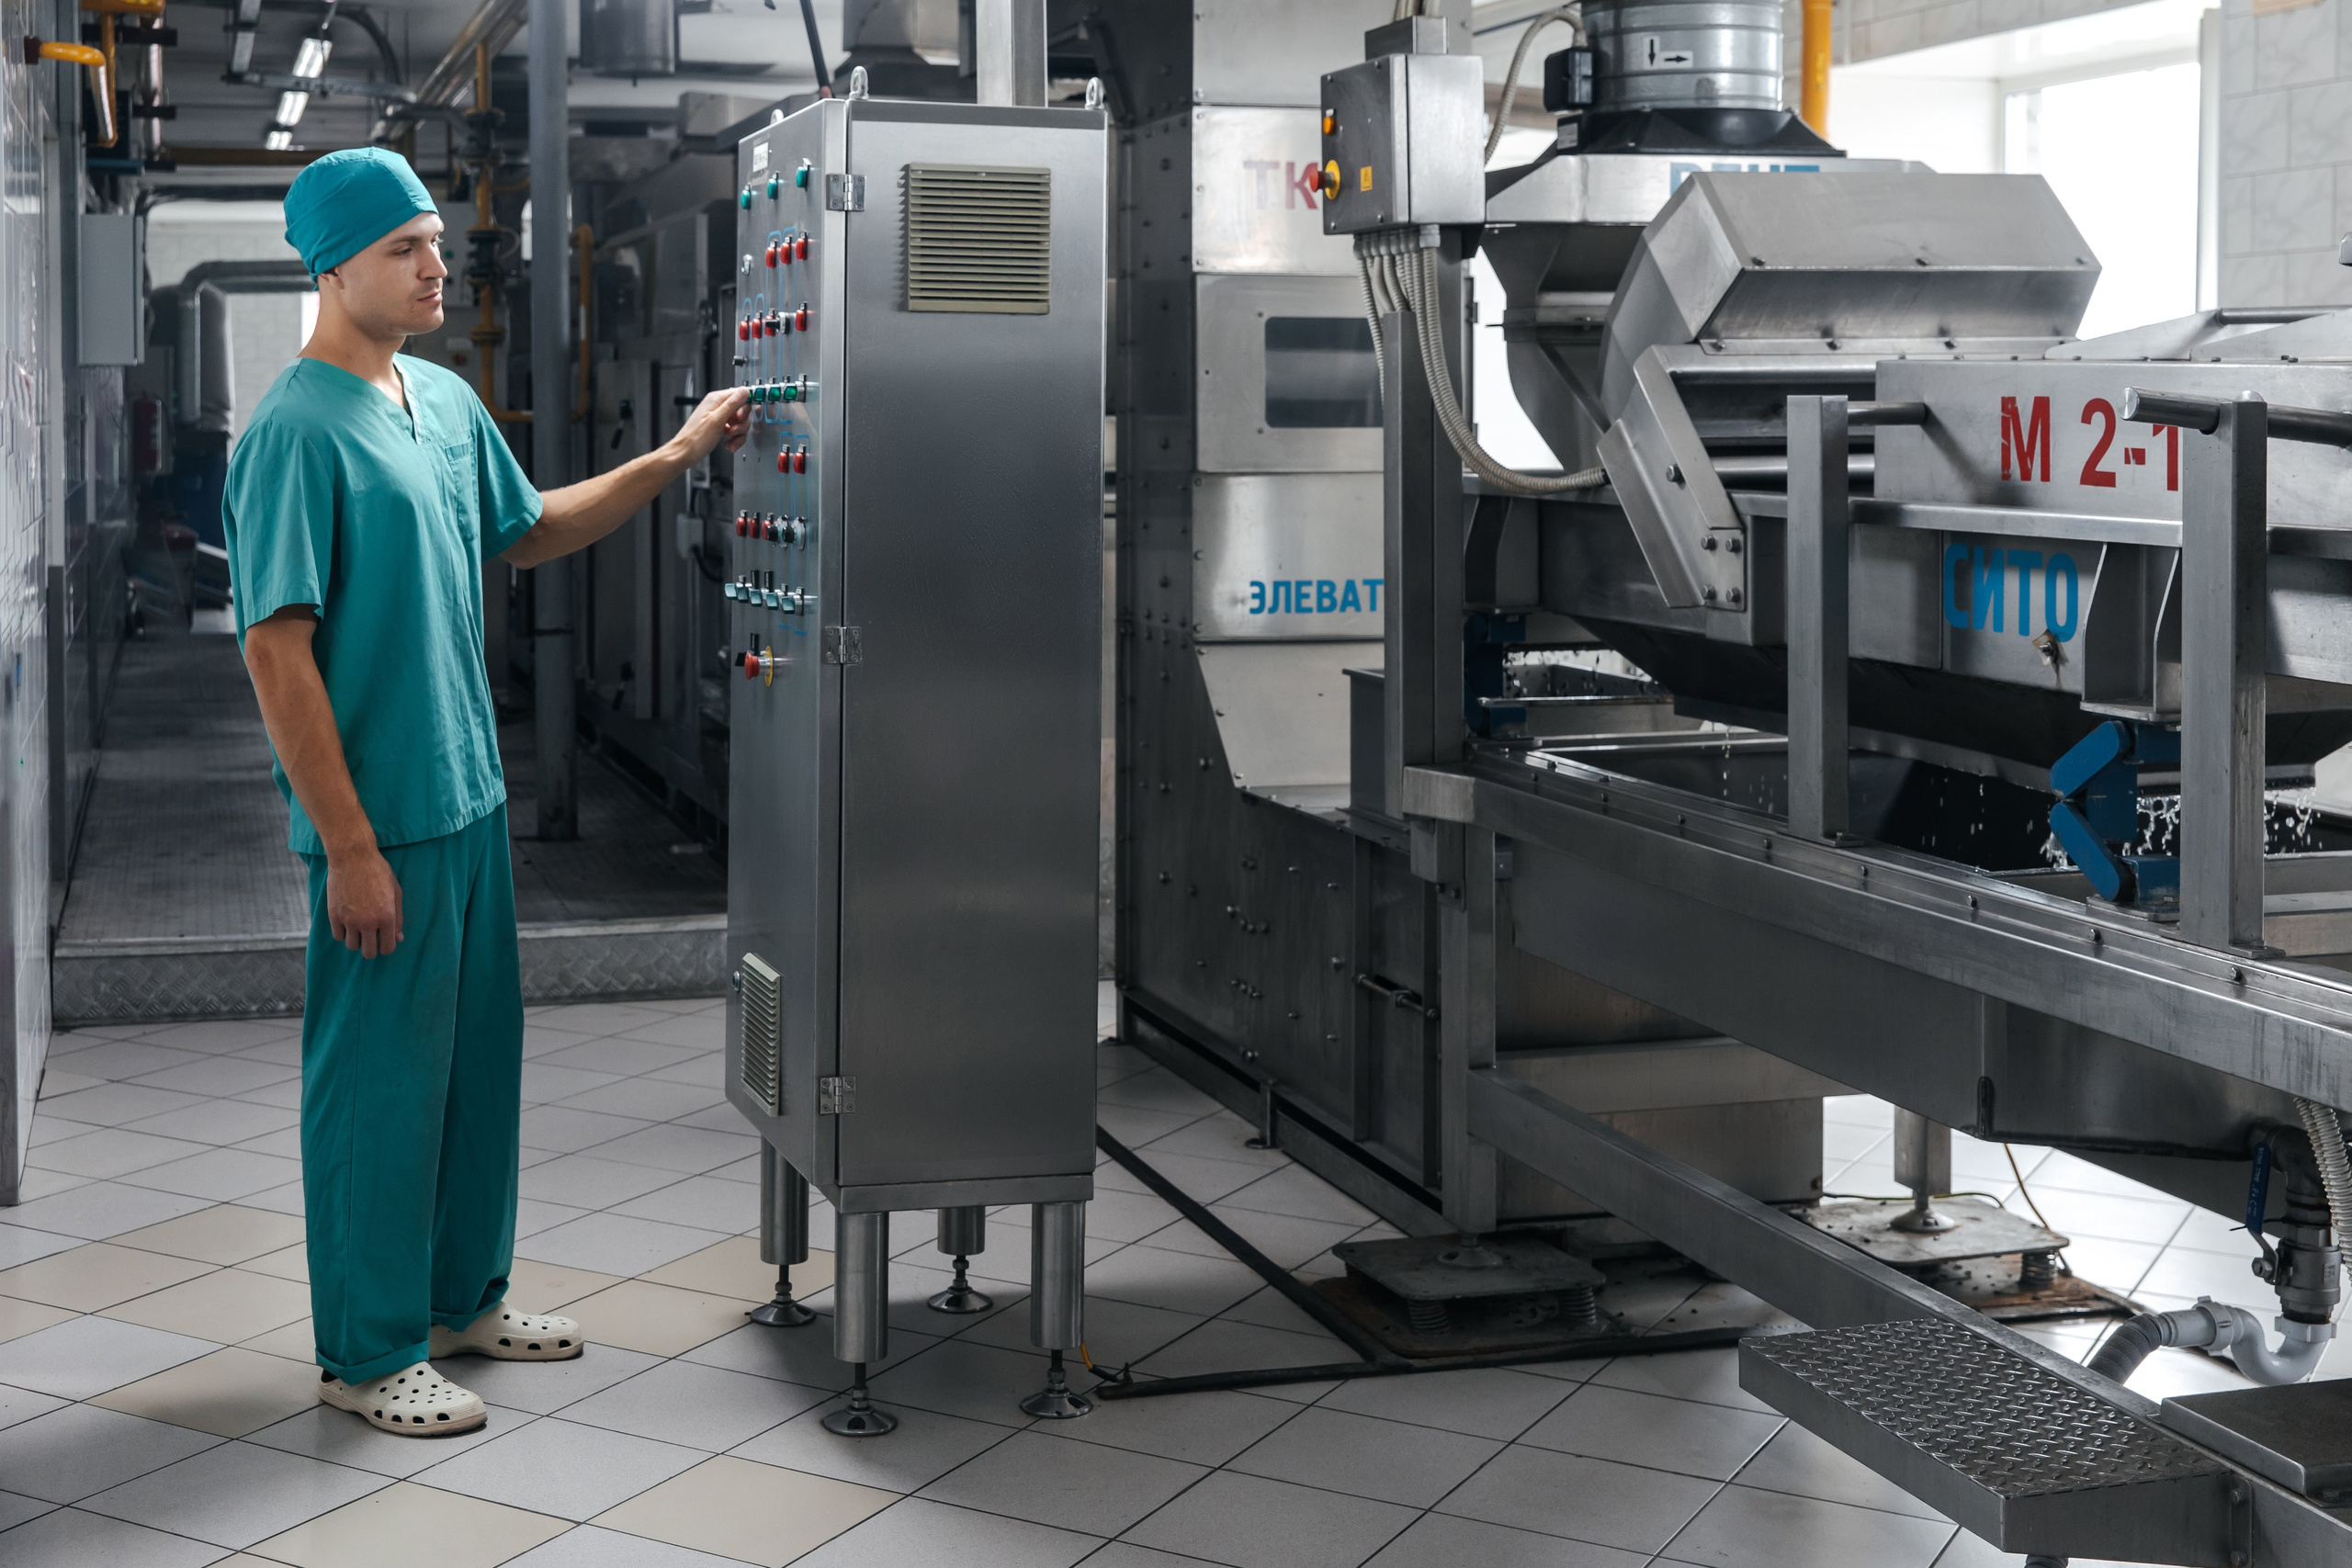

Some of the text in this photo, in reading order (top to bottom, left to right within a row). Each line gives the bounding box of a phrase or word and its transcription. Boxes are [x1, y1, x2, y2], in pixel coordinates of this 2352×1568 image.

[2080, 398, 2178, 491] 2-1
[1250, 579, 1385, 614] ЭЛЕВАТ
[1943, 543, 2078, 643] СИТО
